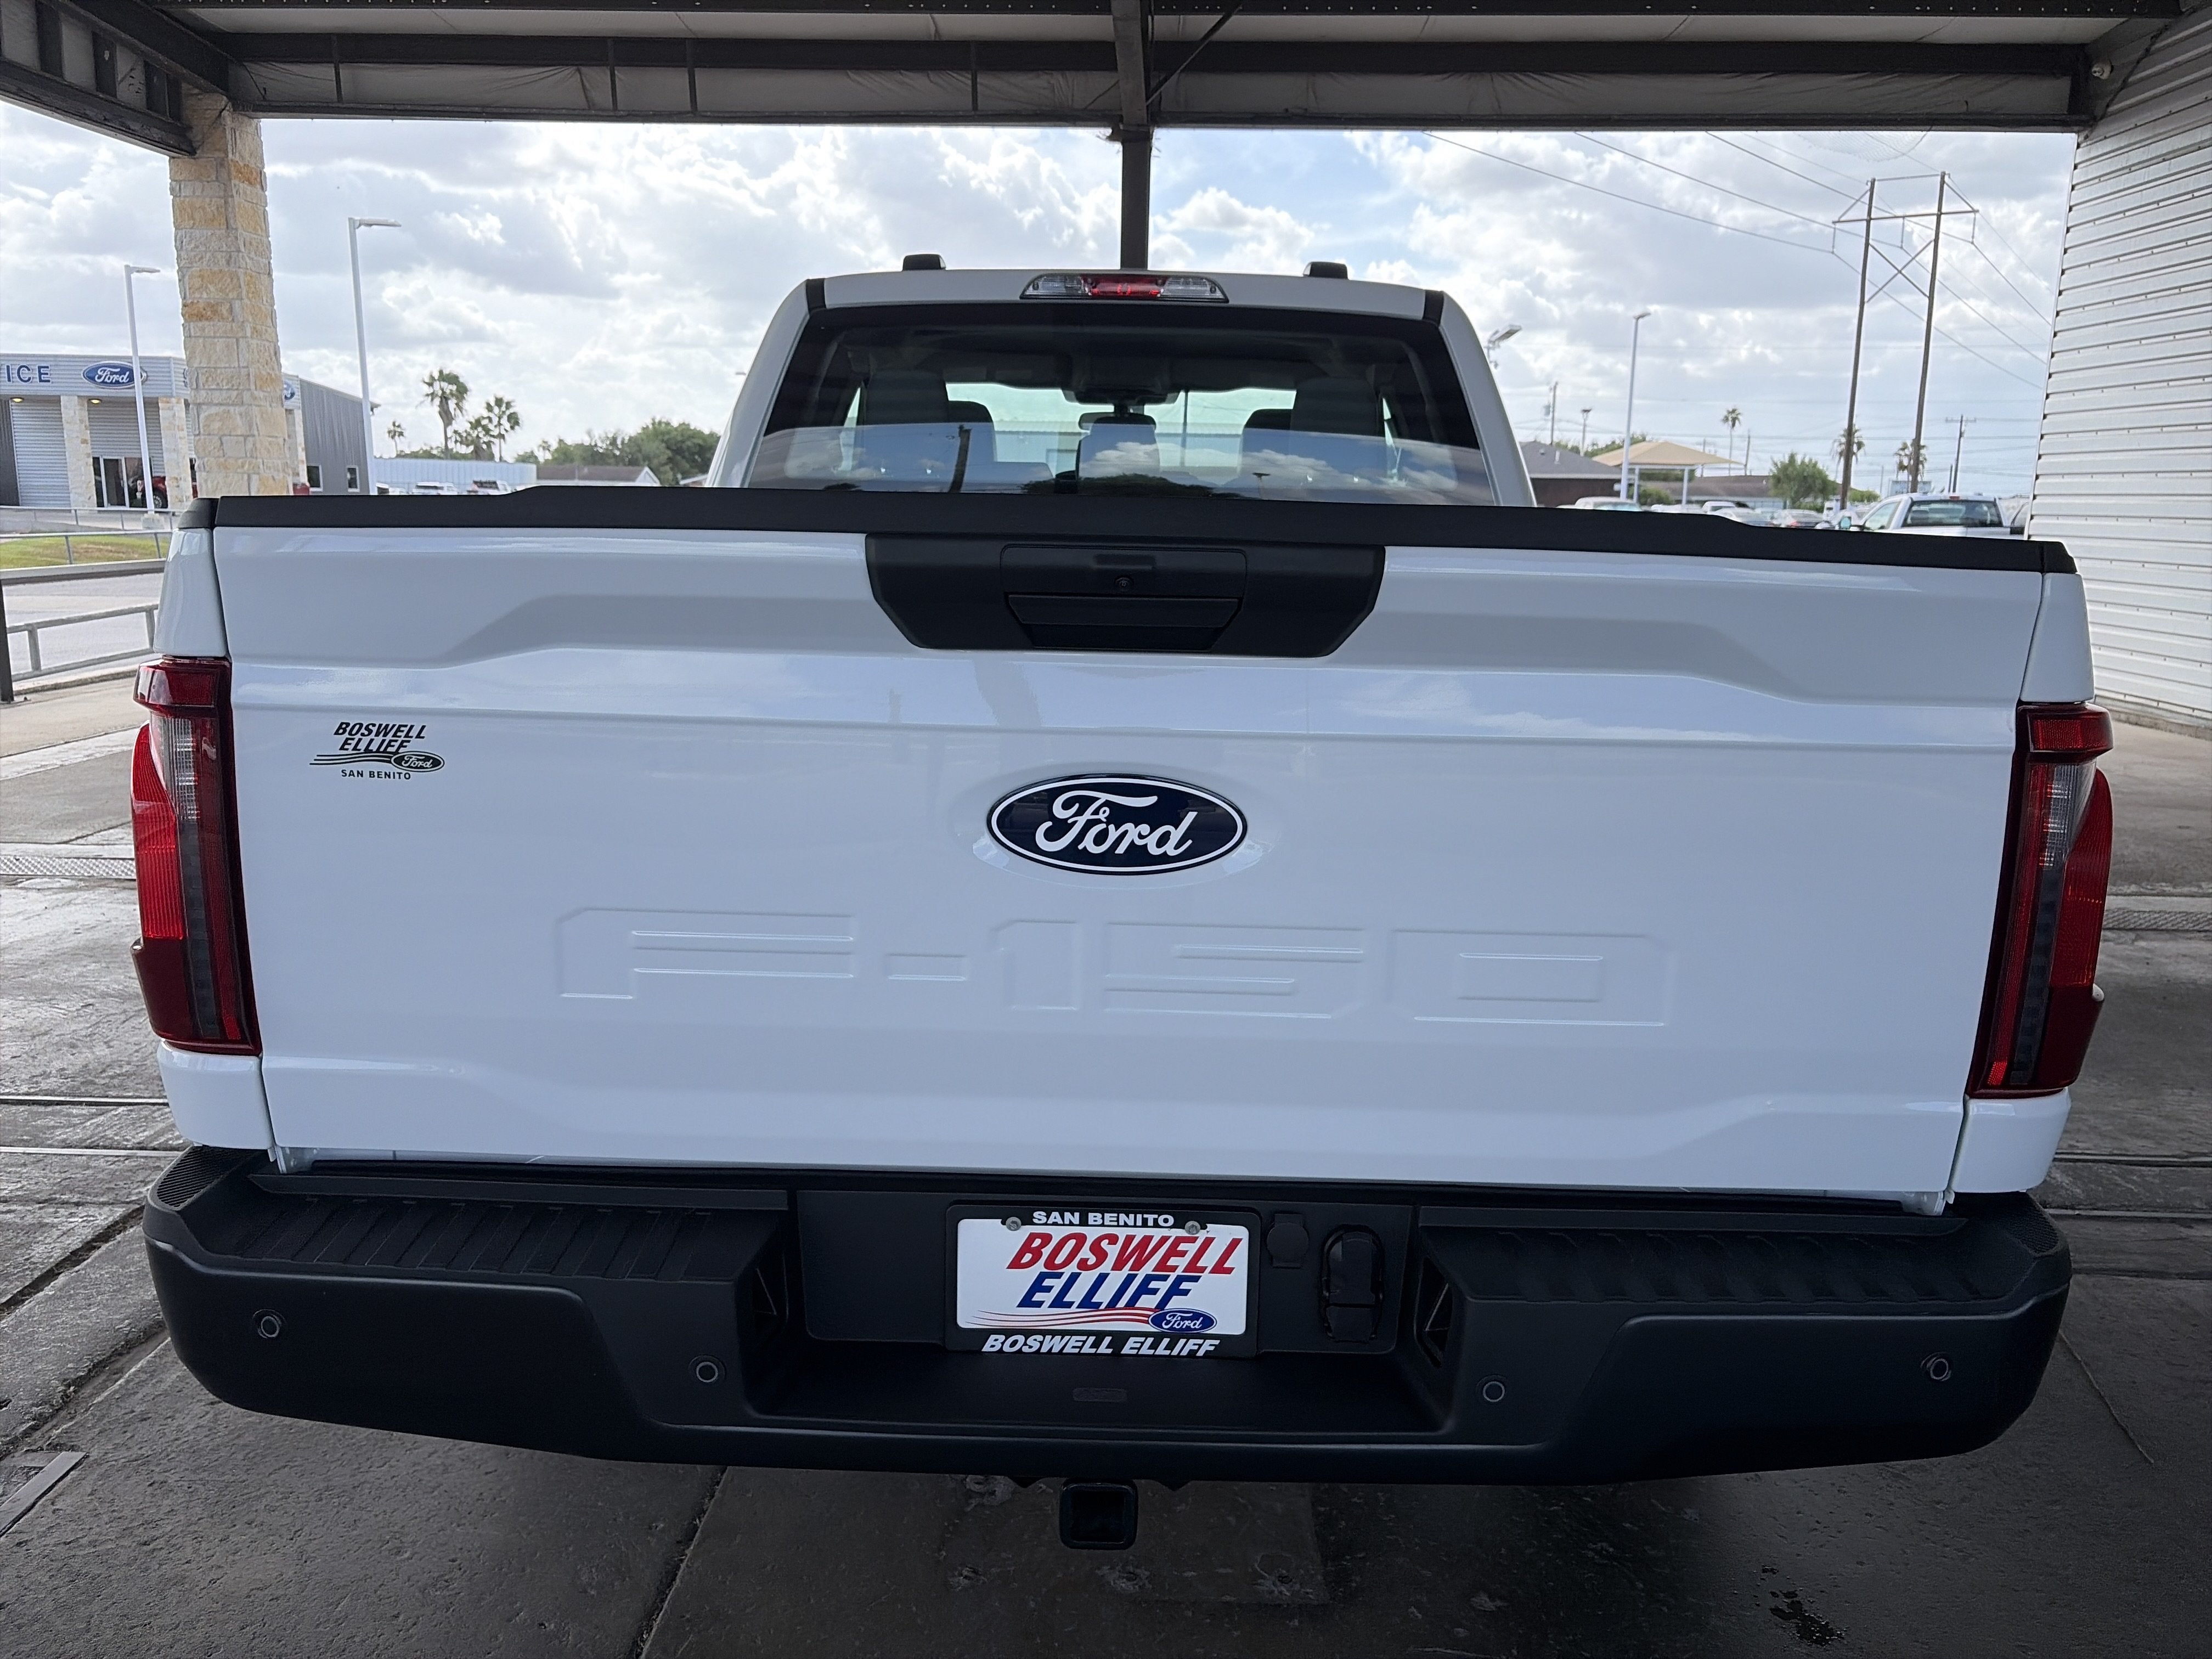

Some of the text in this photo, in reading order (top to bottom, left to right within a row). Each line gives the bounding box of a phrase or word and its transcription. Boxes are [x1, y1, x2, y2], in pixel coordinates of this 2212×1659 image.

[6, 364, 50, 383] ICE
[95, 367, 129, 383] Ford
[334, 721, 426, 738] BOSWELL
[338, 737, 411, 753] ELLIFF
[402, 755, 433, 768] Ford
[341, 769, 411, 780] SAN BENITO
[1035, 790, 1198, 856] Ford
[558, 906, 1674, 1027] F-150
[1032, 1211, 1174, 1227] SAN BENITO
[1006, 1232, 1243, 1274] BOSWELL
[1016, 1271, 1201, 1310] ELLIFF
[1162, 1312, 1202, 1329] Ford
[981, 1335, 1220, 1357] BOSWELL ELLIFF
